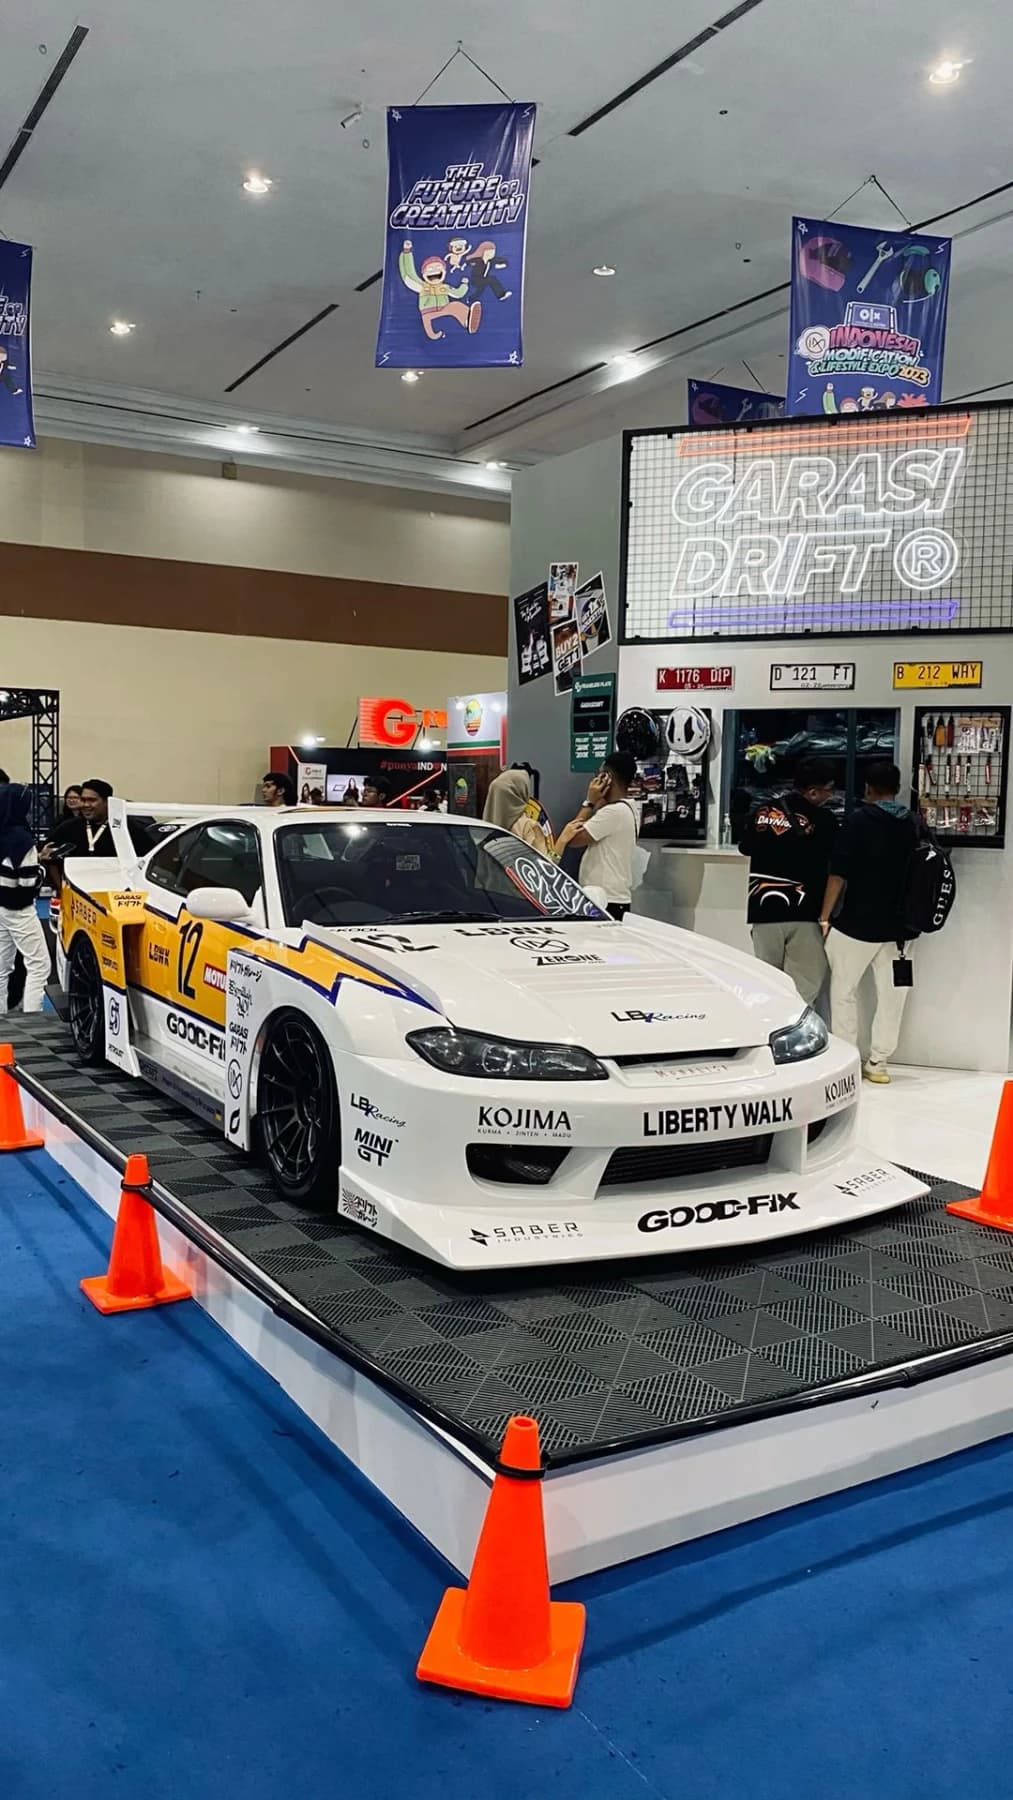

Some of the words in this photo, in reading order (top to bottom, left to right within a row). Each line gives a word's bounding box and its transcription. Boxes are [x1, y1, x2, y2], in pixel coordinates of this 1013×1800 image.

[447, 164, 480, 180] THE
[408, 176, 500, 204] FUTURE
[500, 183, 519, 200] OF
[391, 195, 523, 229] CREATIVITY
[829, 326, 920, 357] INDONESIA
[824, 348, 918, 366] MODIFICATION
[868, 361, 899, 376] EXPO
[897, 366, 929, 384] 2023
[671, 448, 964, 527] GARASI
[669, 529, 893, 599] DRIFT
[659, 670, 666, 683] K
[676, 669, 701, 683] 1176
[710, 668, 731, 682] DIP
[774, 667, 782, 681] D
[793, 667, 817, 680] 121
[833, 666, 850, 680] FT
[896, 666, 904, 679] B
[918, 665, 941, 680] 212
[379, 761, 448, 772] #punyaINDON
[933, 857, 952, 925] GUES
[350, 934, 440, 953] 12
[178, 920, 204, 1001] 12
[531, 954, 602, 966] ZERONE
[204, 966, 227, 991] MOTU
[167, 1012, 226, 1061] GOOD-FI
[825, 1074, 856, 1103] KOJIMA
[365, 1104, 407, 1128] Racing
[478, 1106, 572, 1130] KOJIMA
[643, 1104, 738, 1136] LIBERTY
[742, 1097, 794, 1126] WALK
[354, 1128, 393, 1154] MINI
[358, 1147, 389, 1166] GT
[637, 1192, 801, 1233] GOOD-FIX
[494, 1222, 579, 1240] SABER
